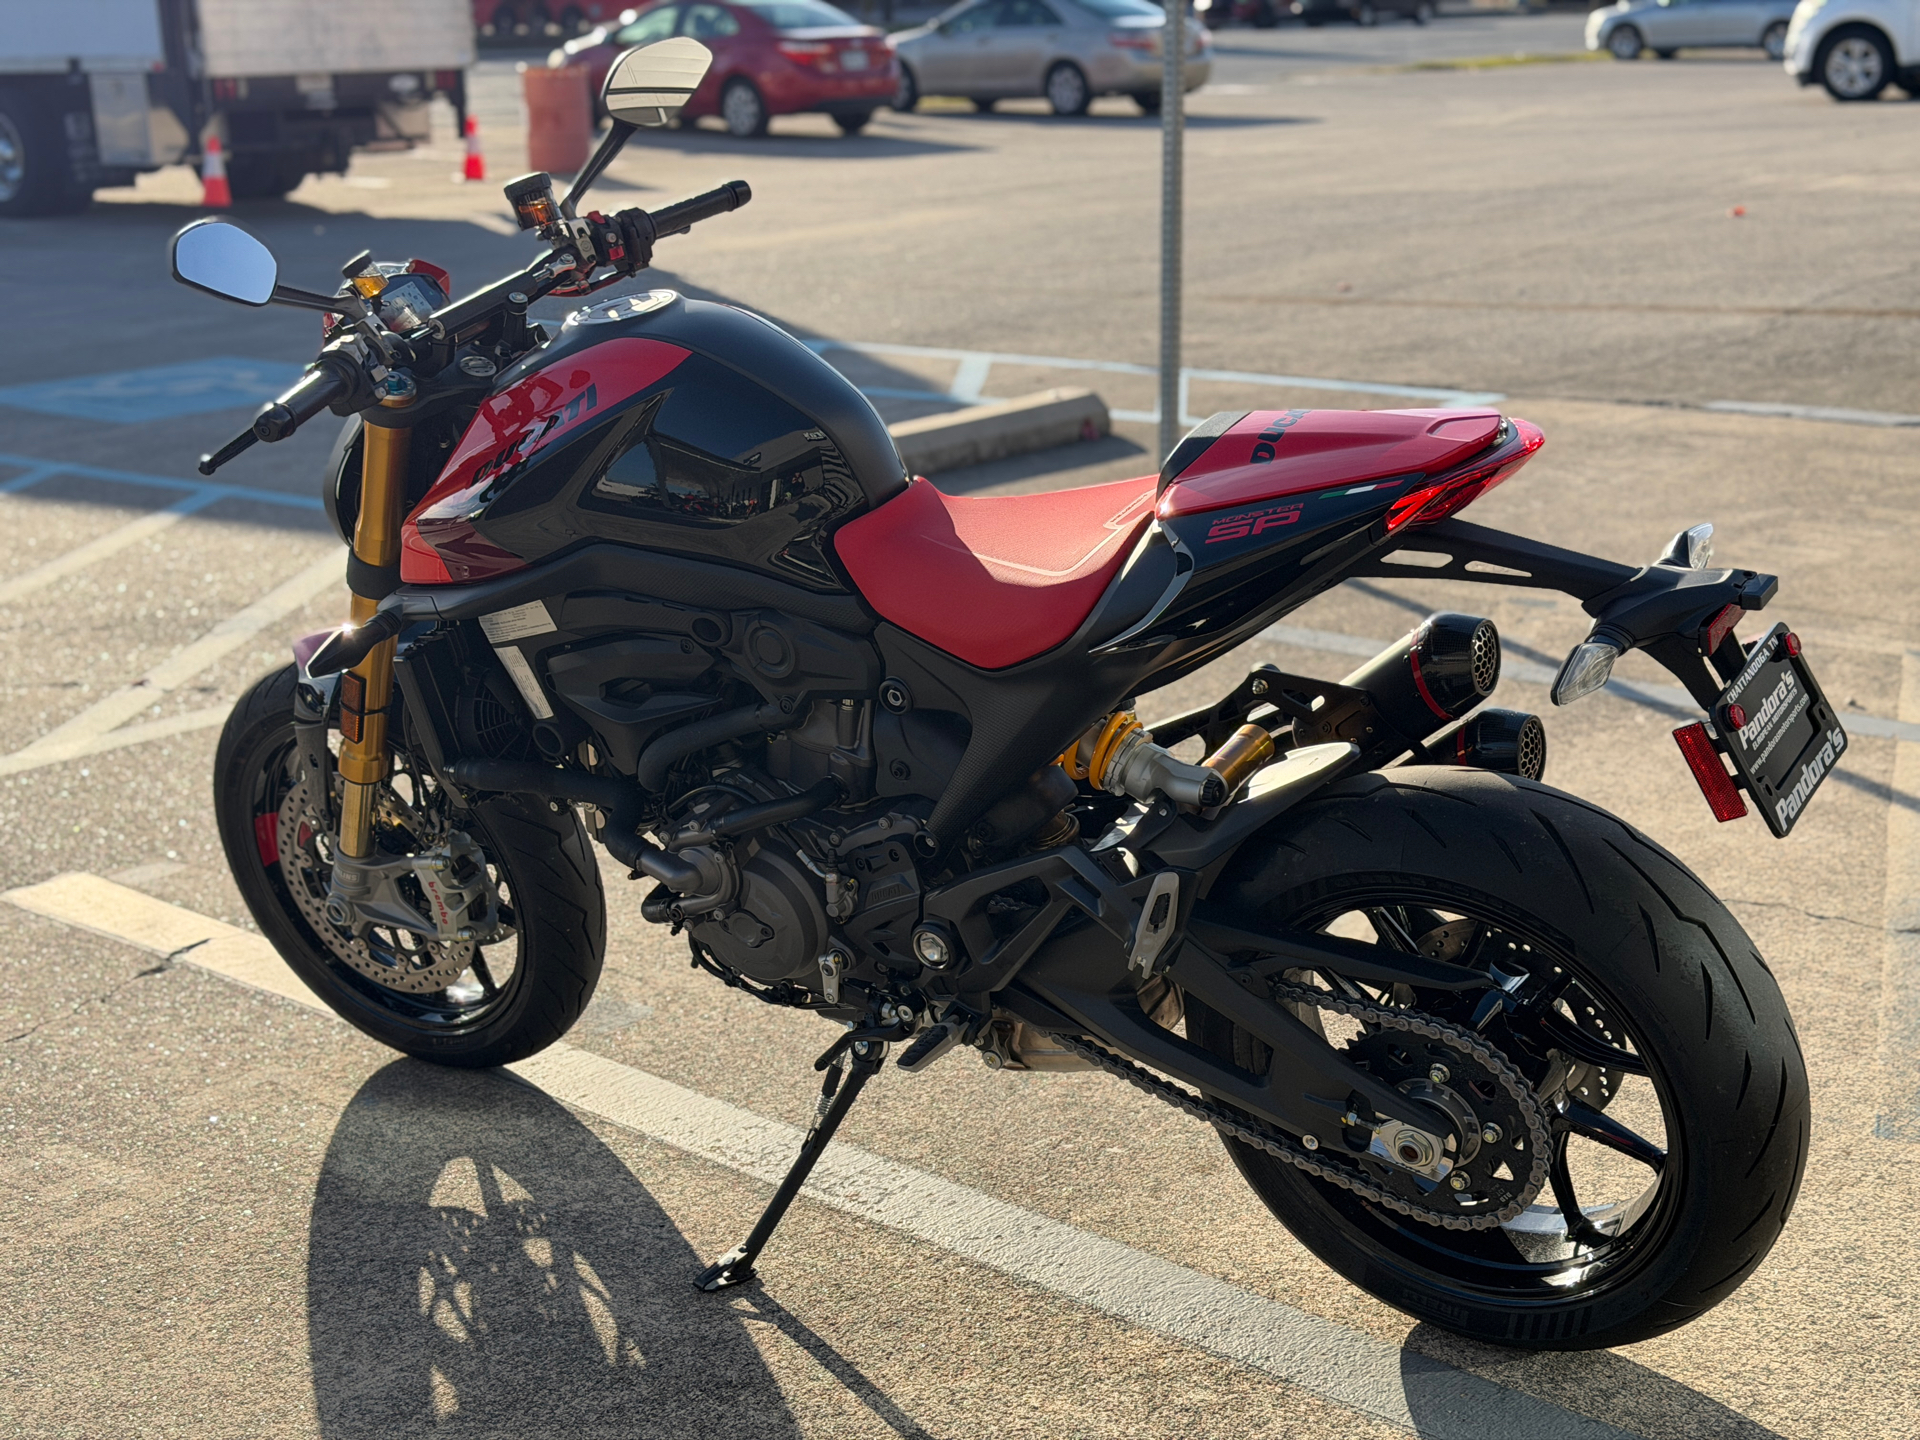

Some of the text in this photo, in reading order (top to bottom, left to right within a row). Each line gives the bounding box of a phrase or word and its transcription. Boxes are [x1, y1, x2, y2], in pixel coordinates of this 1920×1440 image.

[1250, 409, 1312, 465] DUCA
[1205, 510, 1301, 544] SP
[1212, 503, 1304, 525] MONSTER
[1726, 635, 1779, 704] CHATTANOOGA TN
[1738, 670, 1795, 751] Pandora's
[1749, 692, 1810, 775] www.pandorasmotorsports.com
[1752, 687, 1798, 751] EUROPEAN MOTORSPORTS
[1775, 727, 1844, 832] Pandora's
[428, 881, 448, 925] brembo
